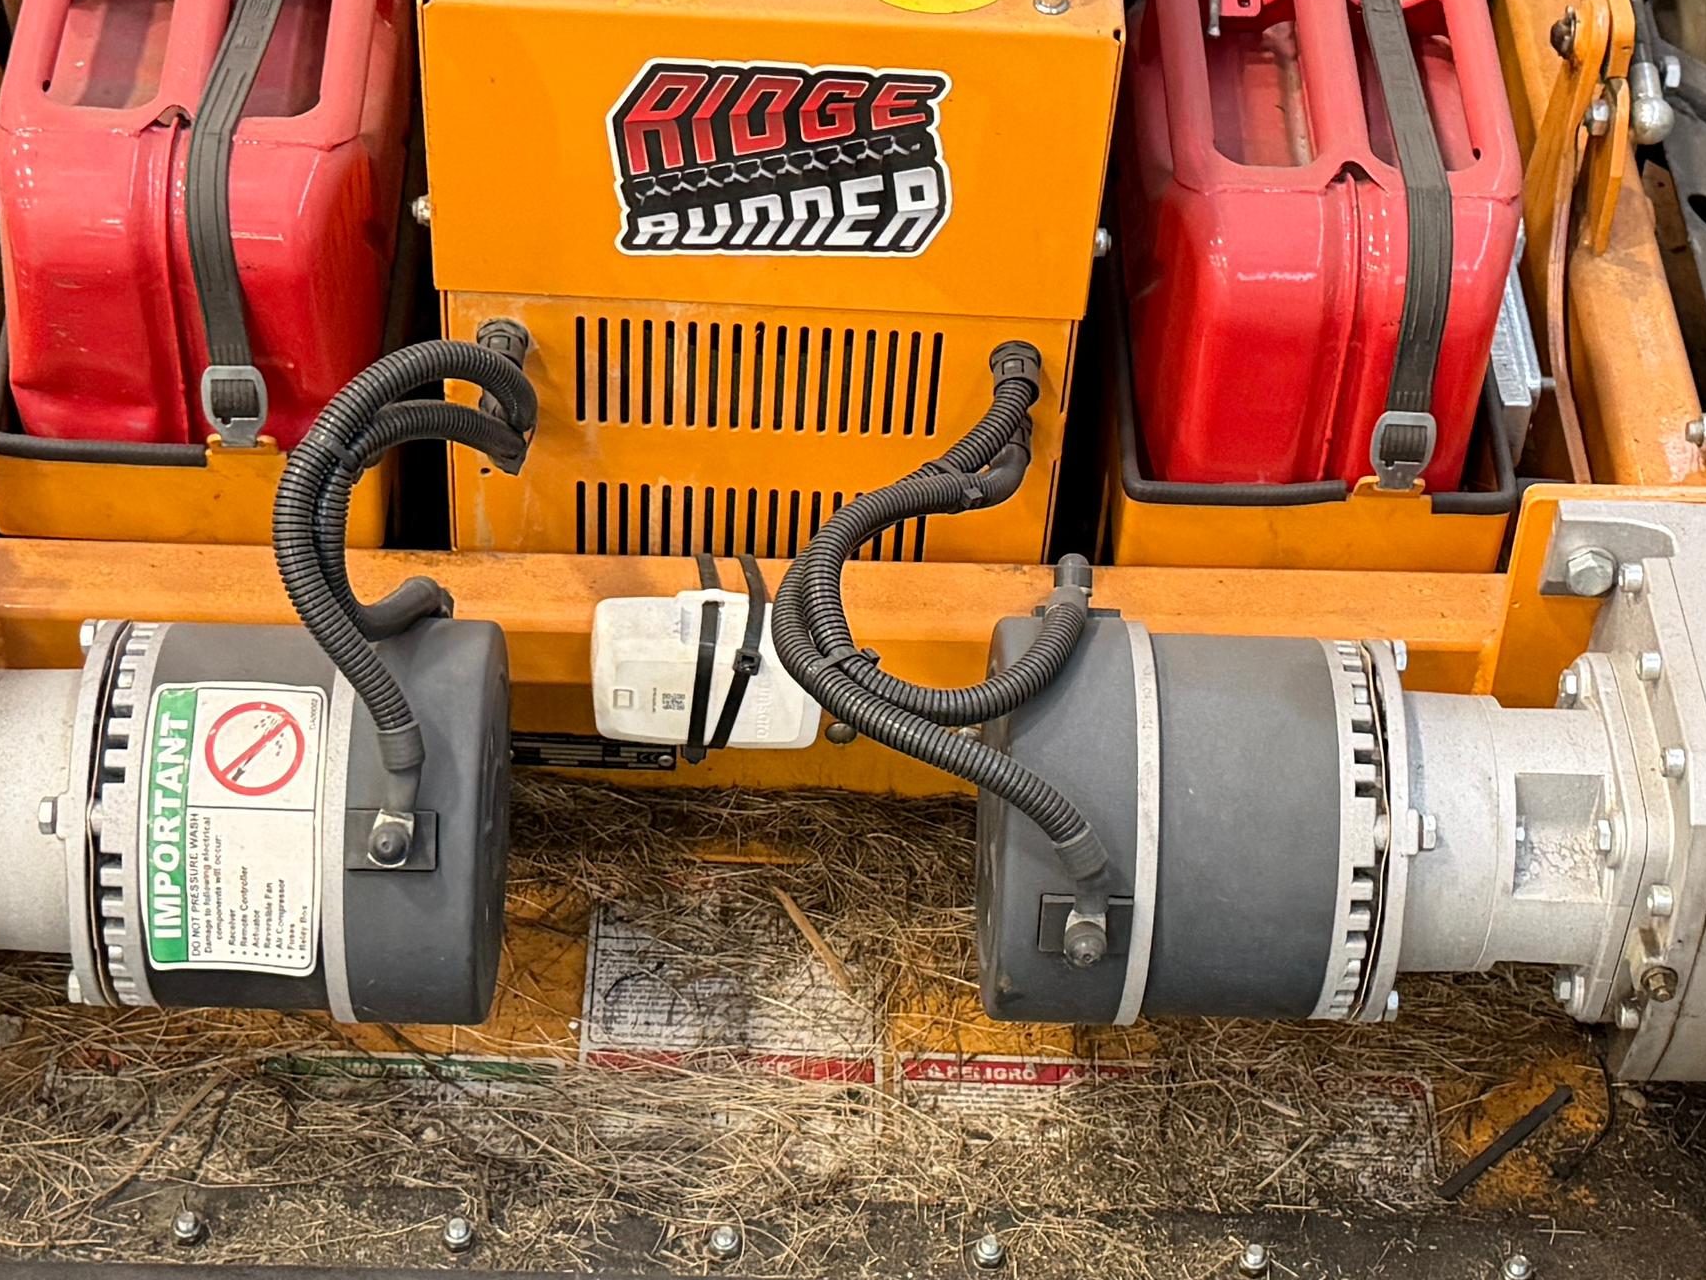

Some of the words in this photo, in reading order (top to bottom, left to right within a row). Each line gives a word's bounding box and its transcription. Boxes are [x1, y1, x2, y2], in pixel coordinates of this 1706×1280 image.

[621, 70, 937, 173] RIDGE
[632, 167, 938, 248] RUNNER
[152, 710, 189, 939] IMPORTANT
[189, 813, 200, 849] WASH
[201, 816, 212, 862] electrical
[189, 852, 201, 913] PRESSURE
[202, 864, 213, 906] following
[213, 867, 222, 884] will
[239, 865, 249, 912] Controller
[264, 881, 273, 900] Fan
[214, 886, 225, 941] components
[263, 901, 273, 950] Reversible
[275, 878, 287, 935] Compressor
[190, 916, 201, 938] NOT
[203, 919, 214, 954] Damage
[228, 909, 237, 947] Receiver
[239, 913, 249, 948] Remote
[252, 909, 261, 949] Actuator
[275, 937, 284, 950] Air
[287, 923, 296, 951] Fuses
[298, 926, 310, 951] Relay
[191, 941, 201, 957] DO
